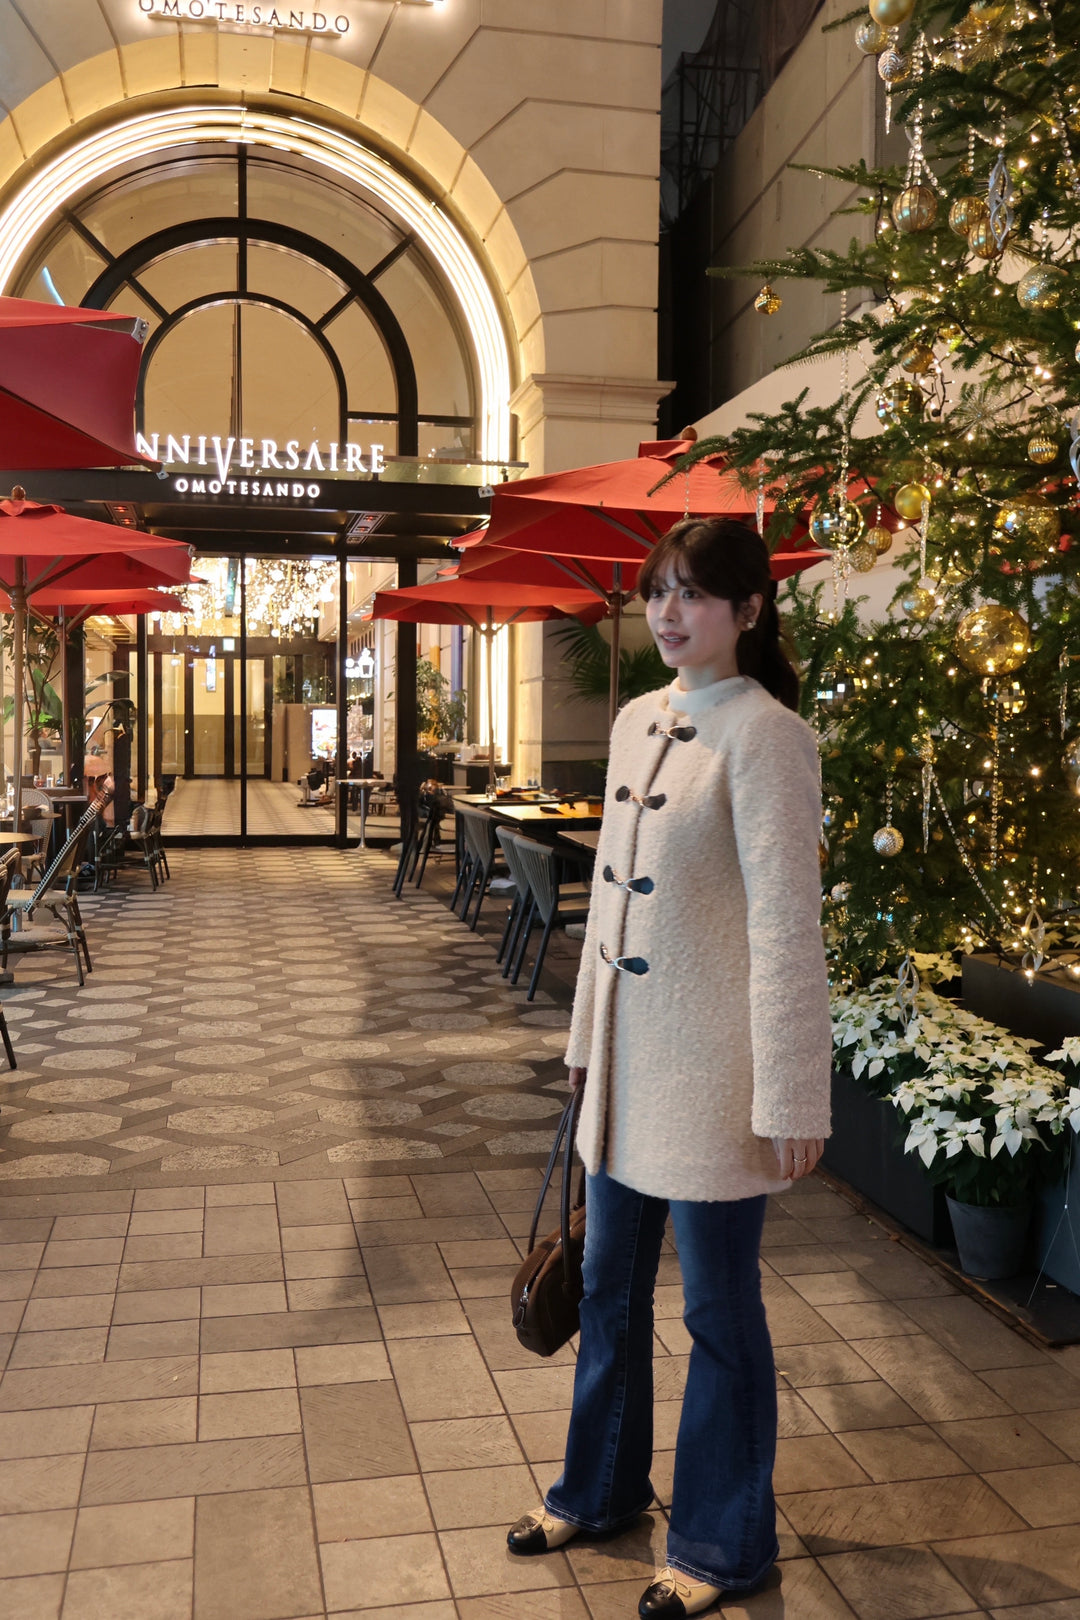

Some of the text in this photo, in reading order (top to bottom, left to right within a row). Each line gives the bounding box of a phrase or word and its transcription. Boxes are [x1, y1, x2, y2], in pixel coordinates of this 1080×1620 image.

[139, 0, 350, 33] OMOTESANDO
[135, 432, 385, 485] NNIVERSAIRE
[174, 479, 321, 498] OMOTESANDO
